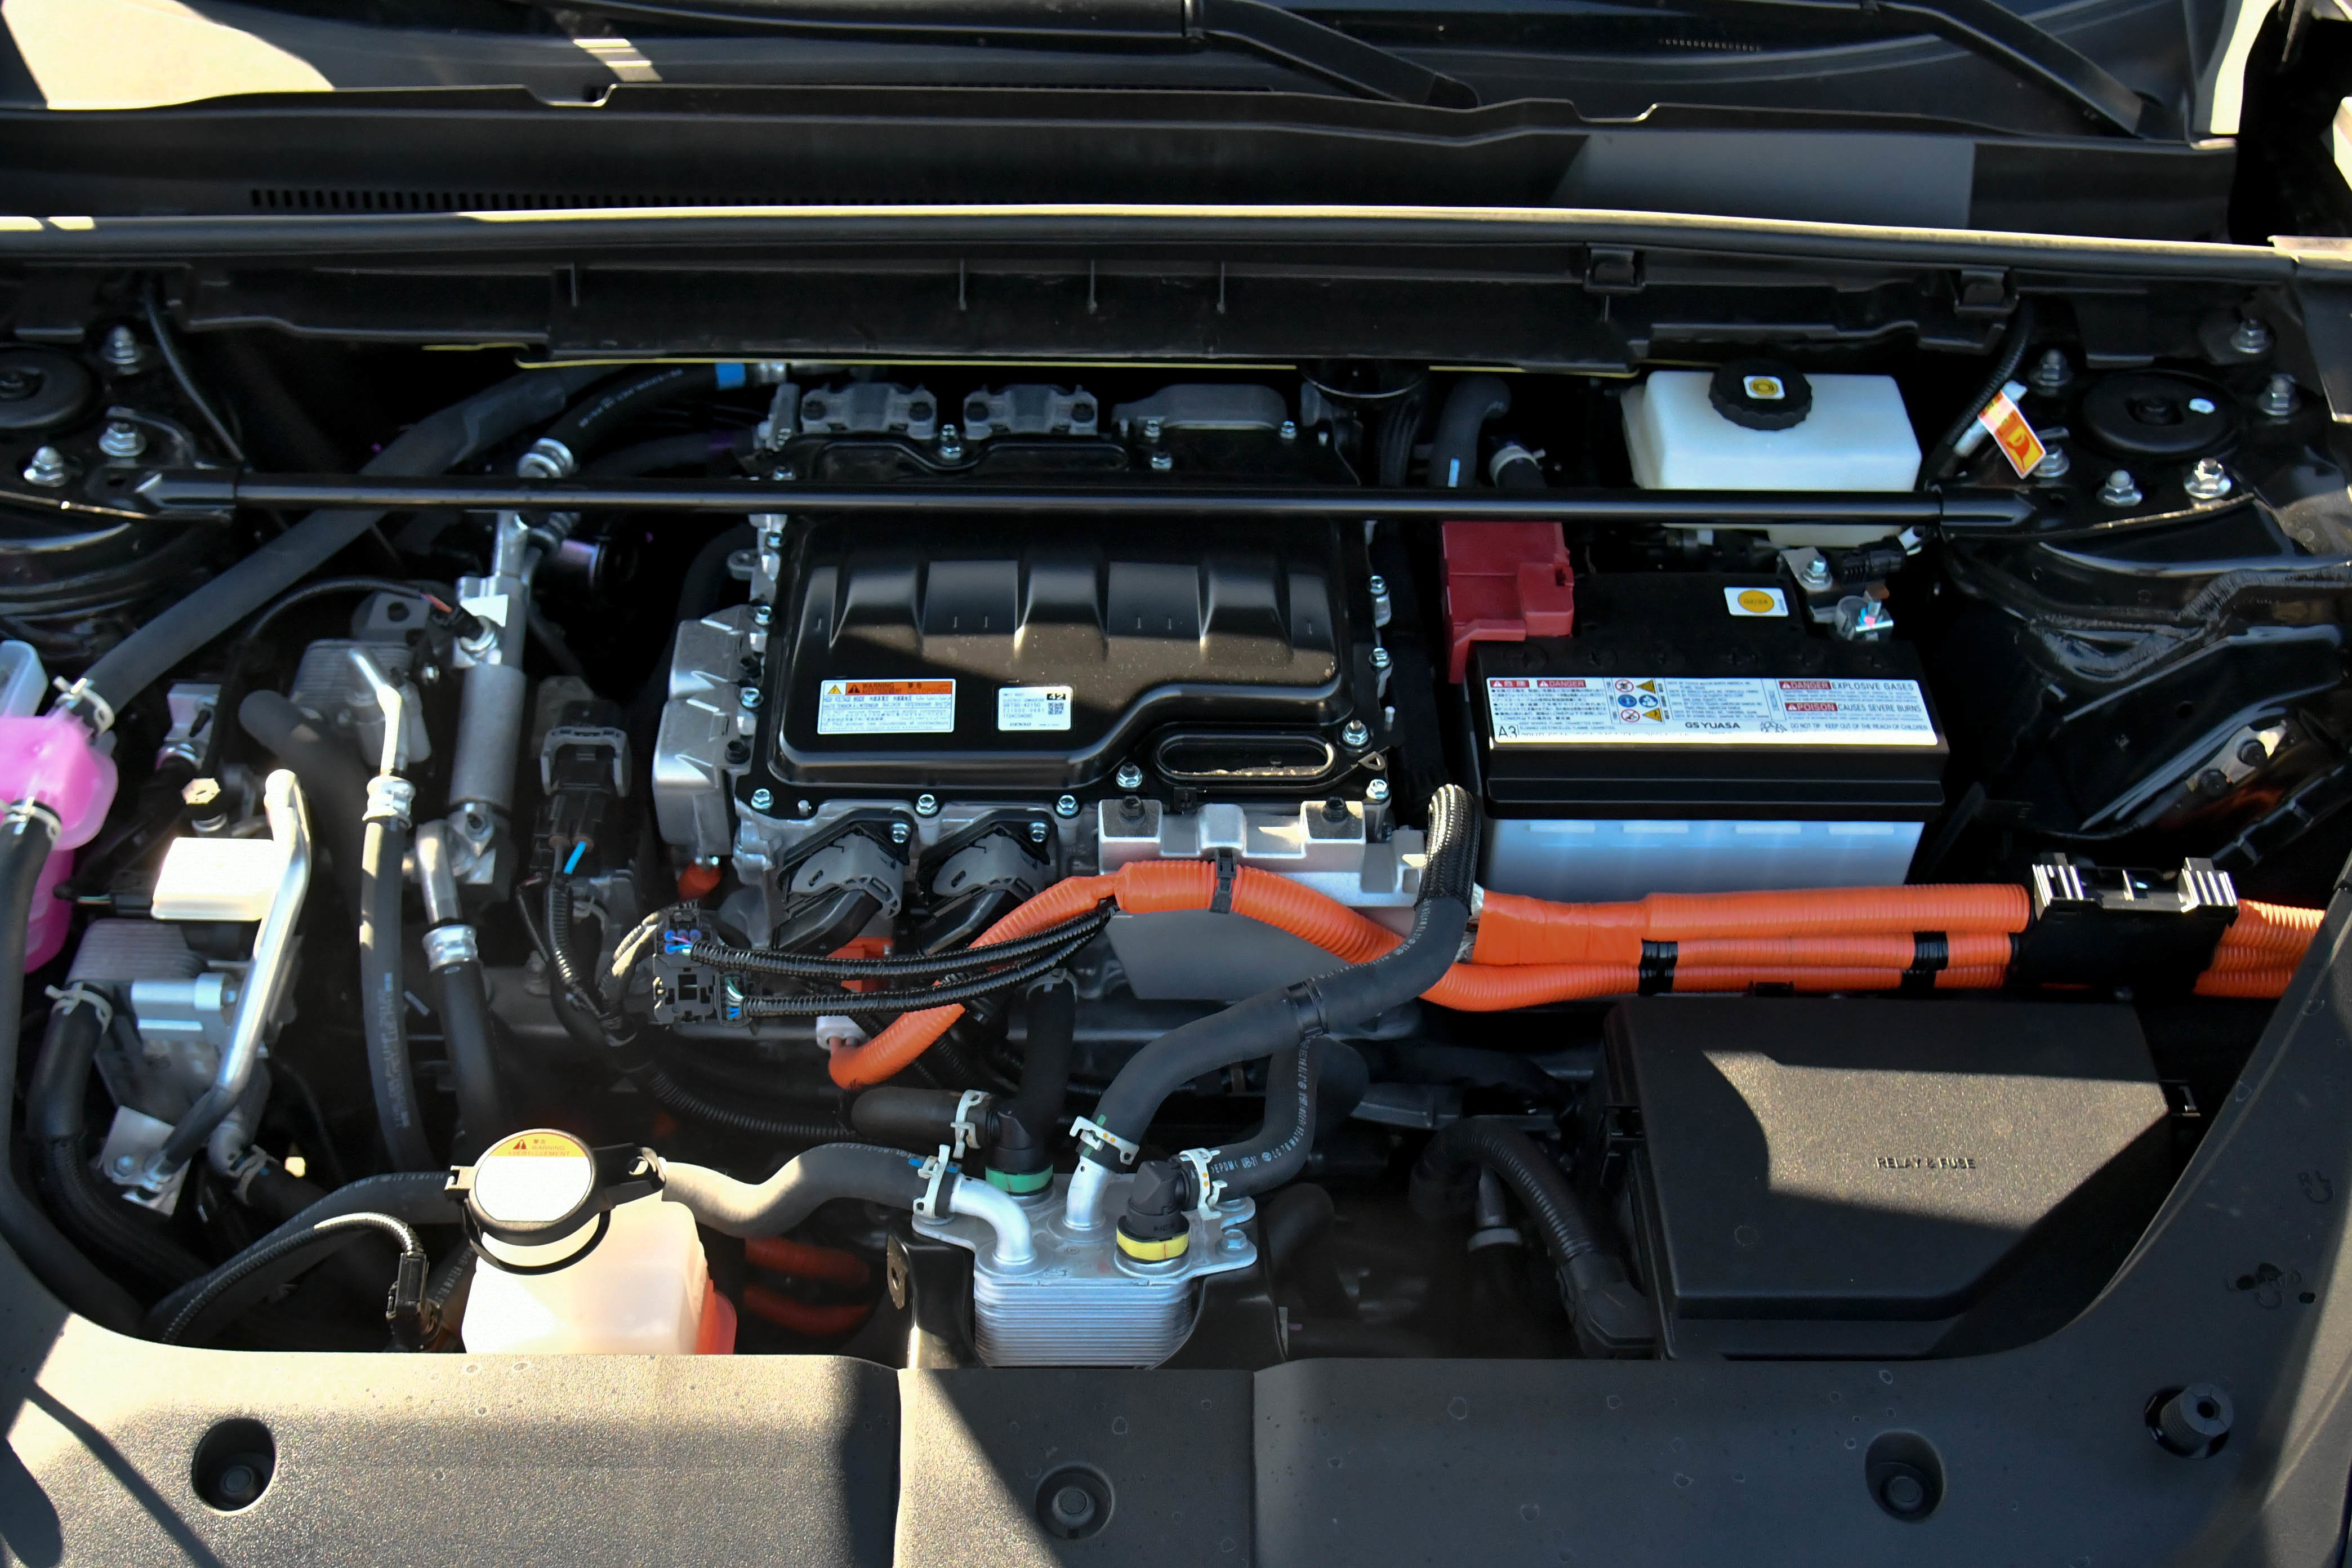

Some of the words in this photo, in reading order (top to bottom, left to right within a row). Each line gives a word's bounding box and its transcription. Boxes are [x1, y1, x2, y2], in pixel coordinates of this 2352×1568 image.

[1790, 681, 1830, 689] DANGER
[1884, 682, 1914, 691] GASES
[1498, 725, 1517, 738] A3
[1876, 1157, 1921, 1169] RELAY
[1926, 1157, 1937, 1169] &
[1938, 1157, 1976, 1169] FUSE
